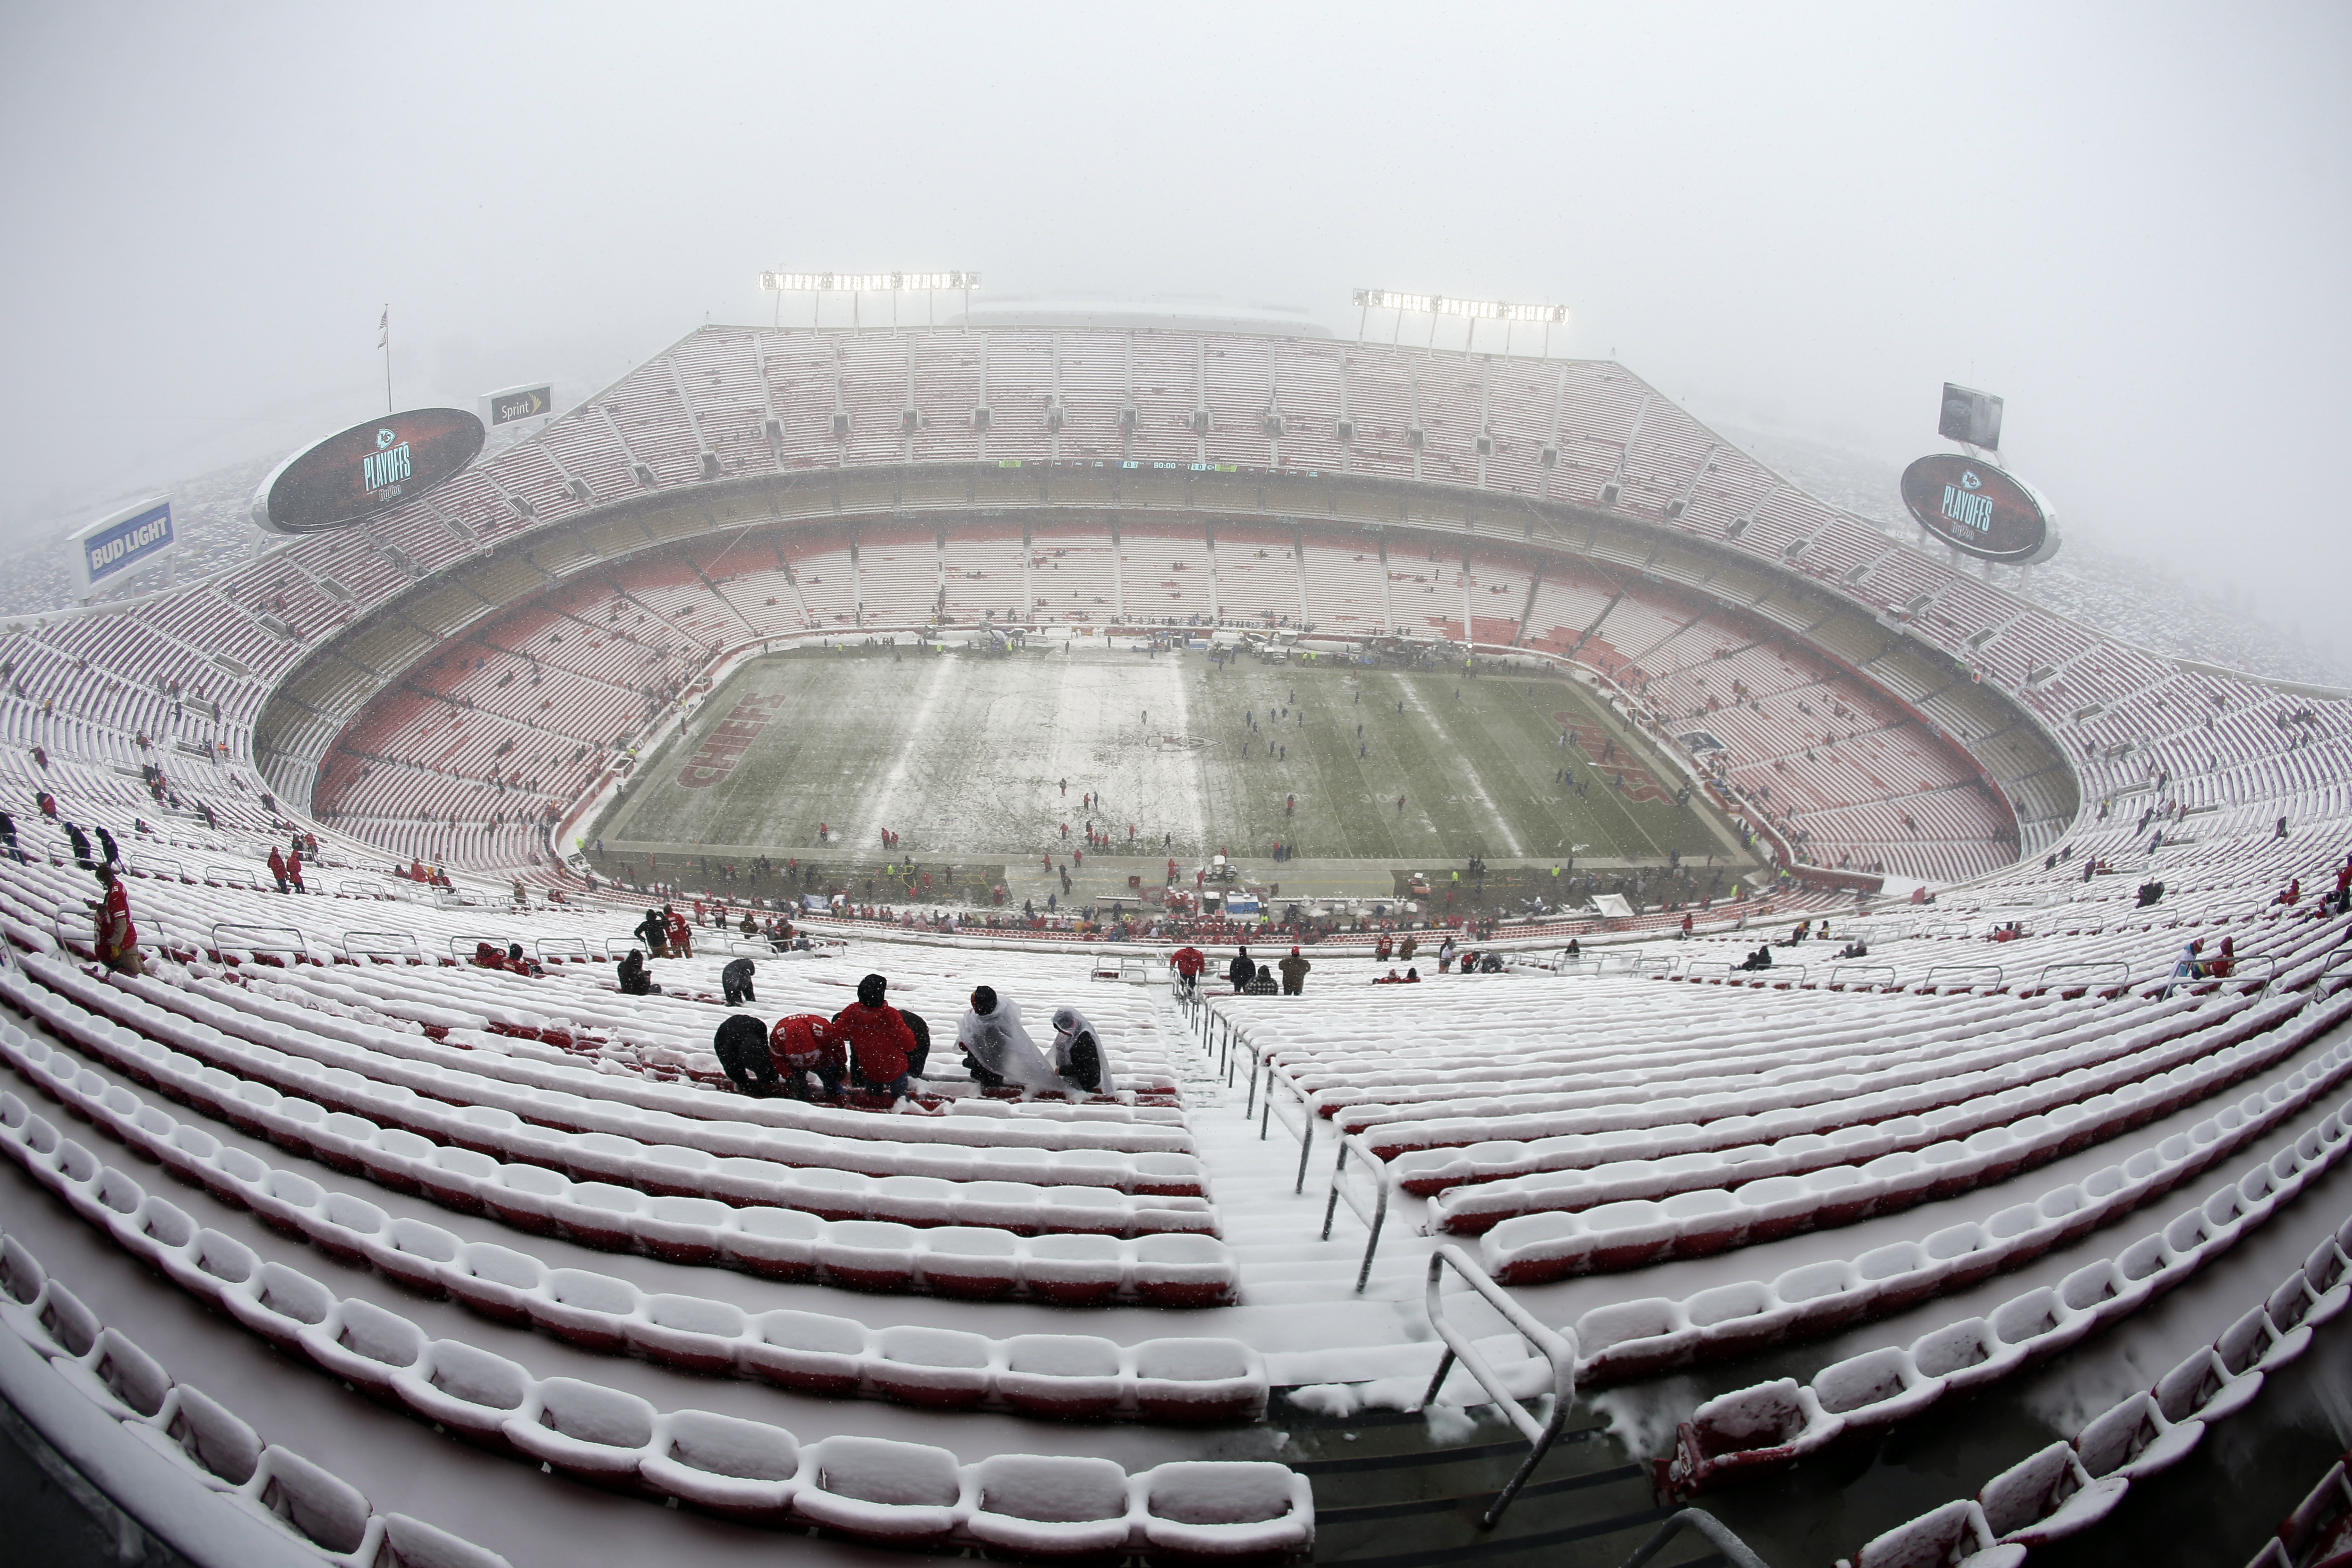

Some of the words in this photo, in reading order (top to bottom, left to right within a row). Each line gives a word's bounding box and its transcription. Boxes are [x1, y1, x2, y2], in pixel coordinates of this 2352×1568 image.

[502, 401, 529, 421] Sprint
[364, 445, 411, 492] PLAYOFFS
[1941, 485, 1993, 532] PLAYOFFS
[91, 538, 124, 570] BUD
[125, 517, 167, 553] LIGHT
[677, 692, 786, 789] CHIEFS
[1551, 711, 1679, 806] CHIEFS
[1530, 796, 1556, 805] 10
[669, 921, 679, 933] 15
[812, 1023, 823, 1037] 87
